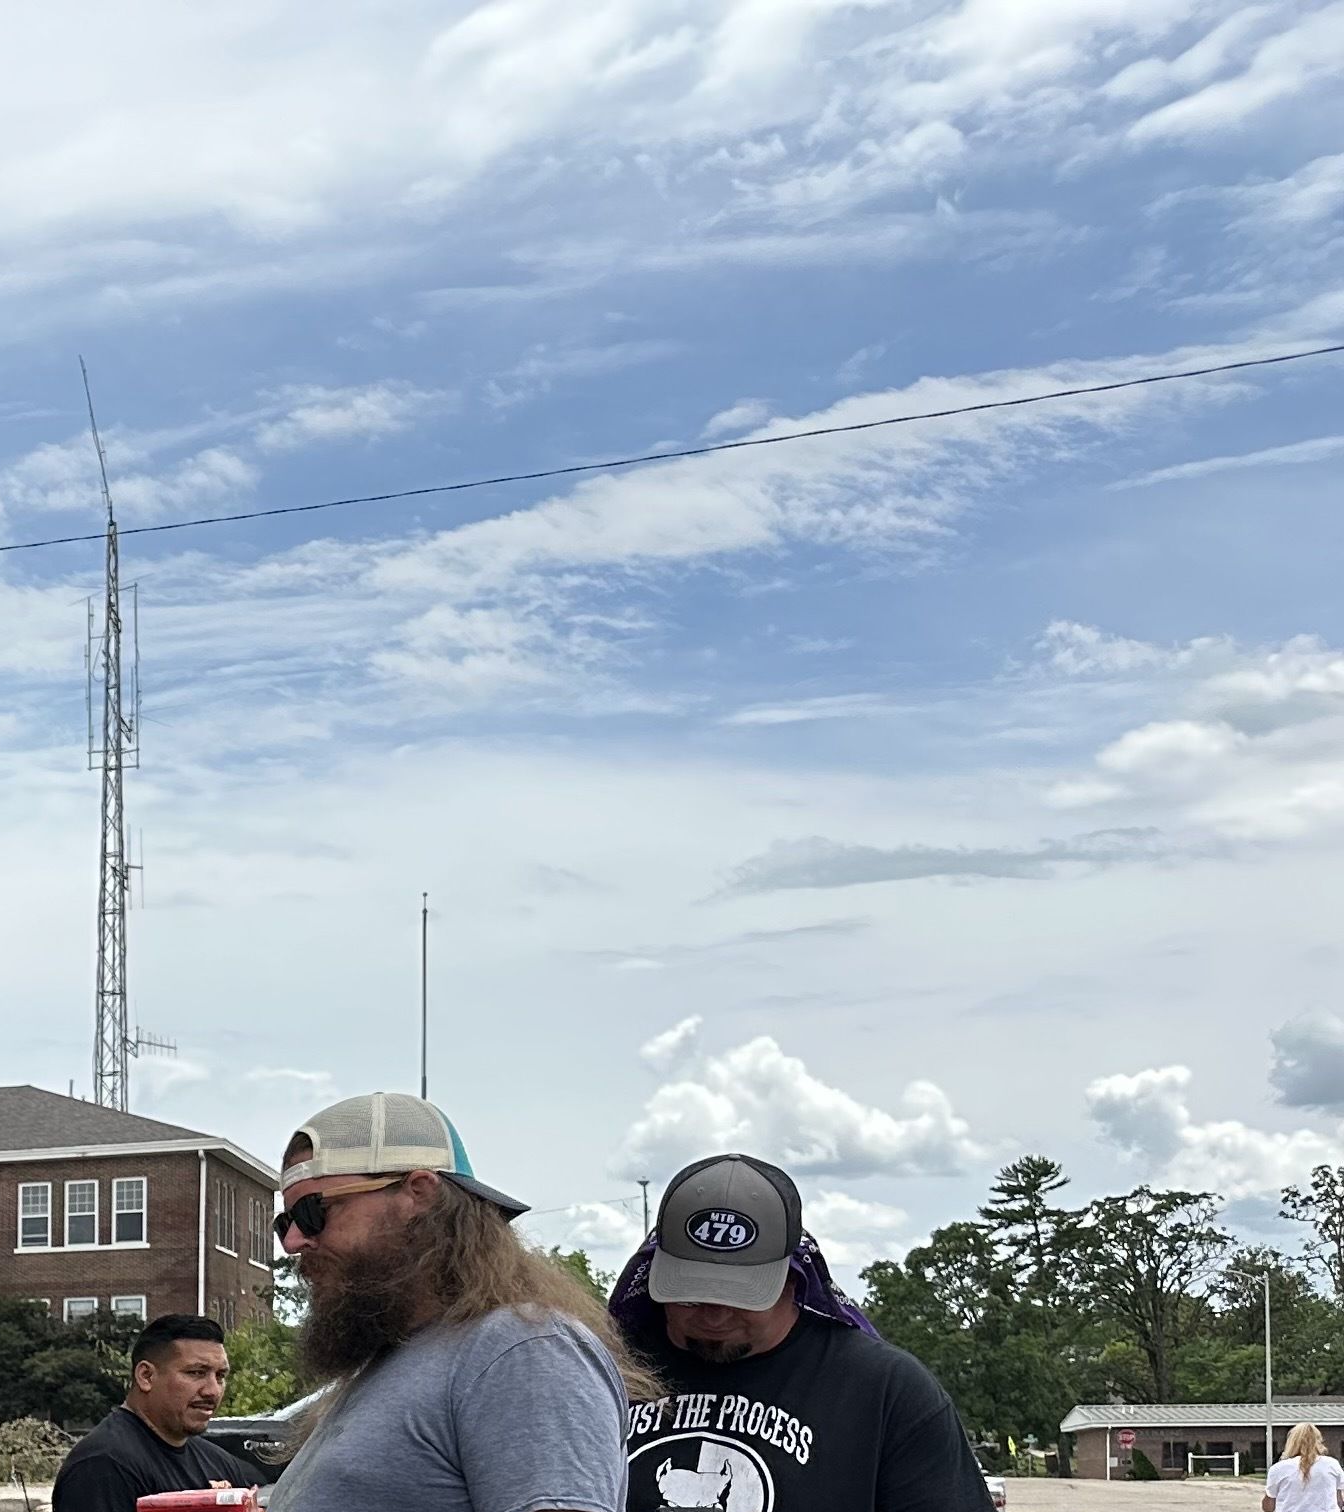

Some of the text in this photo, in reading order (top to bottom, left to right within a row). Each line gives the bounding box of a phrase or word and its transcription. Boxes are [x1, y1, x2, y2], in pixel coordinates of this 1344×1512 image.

[710, 1212, 736, 1224] MTB
[694, 1221, 747, 1245] 479
[672, 1393, 717, 1429] THE
[716, 1394, 813, 1465] PROCESS
